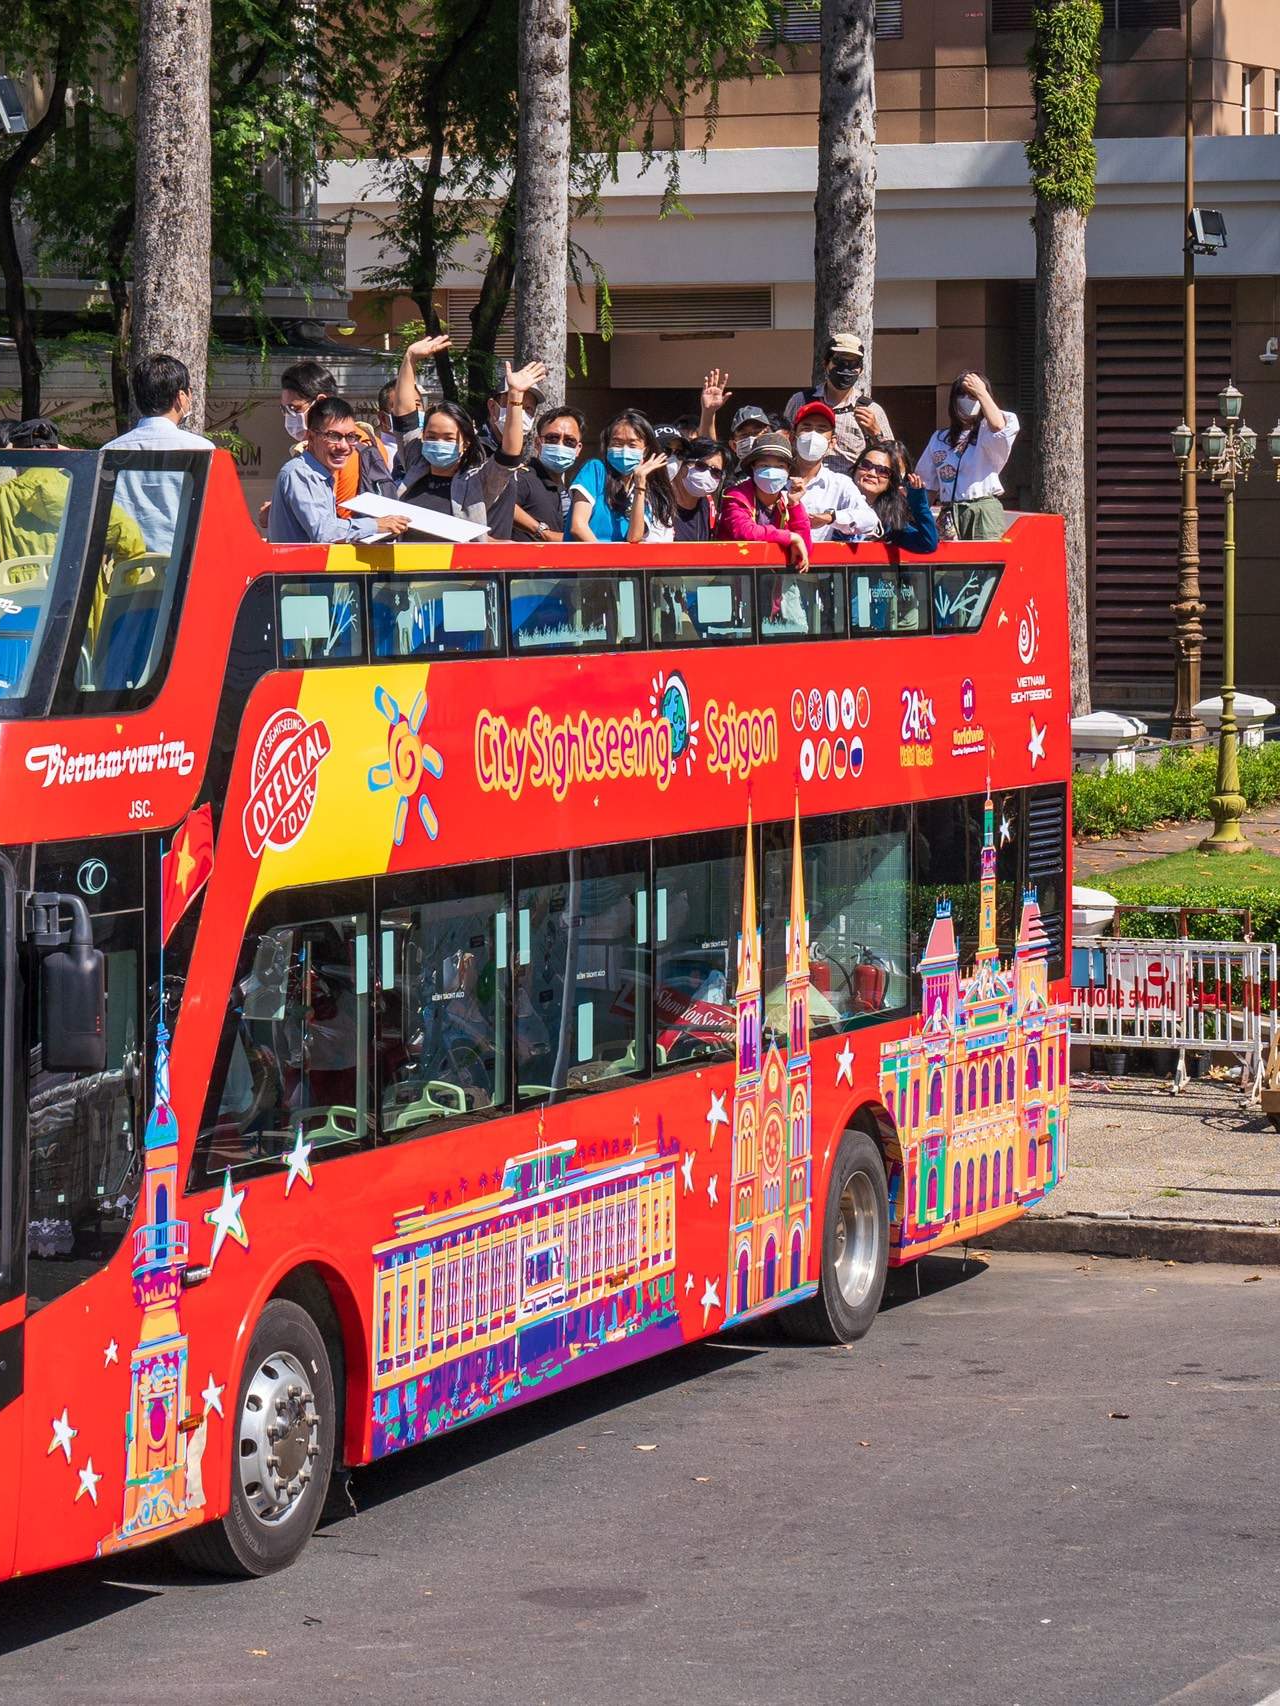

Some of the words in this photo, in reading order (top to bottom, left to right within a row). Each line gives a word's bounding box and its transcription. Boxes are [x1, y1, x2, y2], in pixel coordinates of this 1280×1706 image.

[1017, 675, 1045, 688] VIETNAM
[901, 690, 919, 740] 24
[25, 731, 195, 788] Vietnamtourism
[257, 748, 268, 778] CITY
[264, 717, 303, 752] SIGHTSEEING
[475, 708, 528, 801] City
[527, 706, 672, 802] Sightseeing
[704, 698, 779, 780] Saigon
[128, 799, 154, 819] JSC.
[253, 728, 327, 837] OFFICIAL
[281, 783, 315, 838] TOUR
